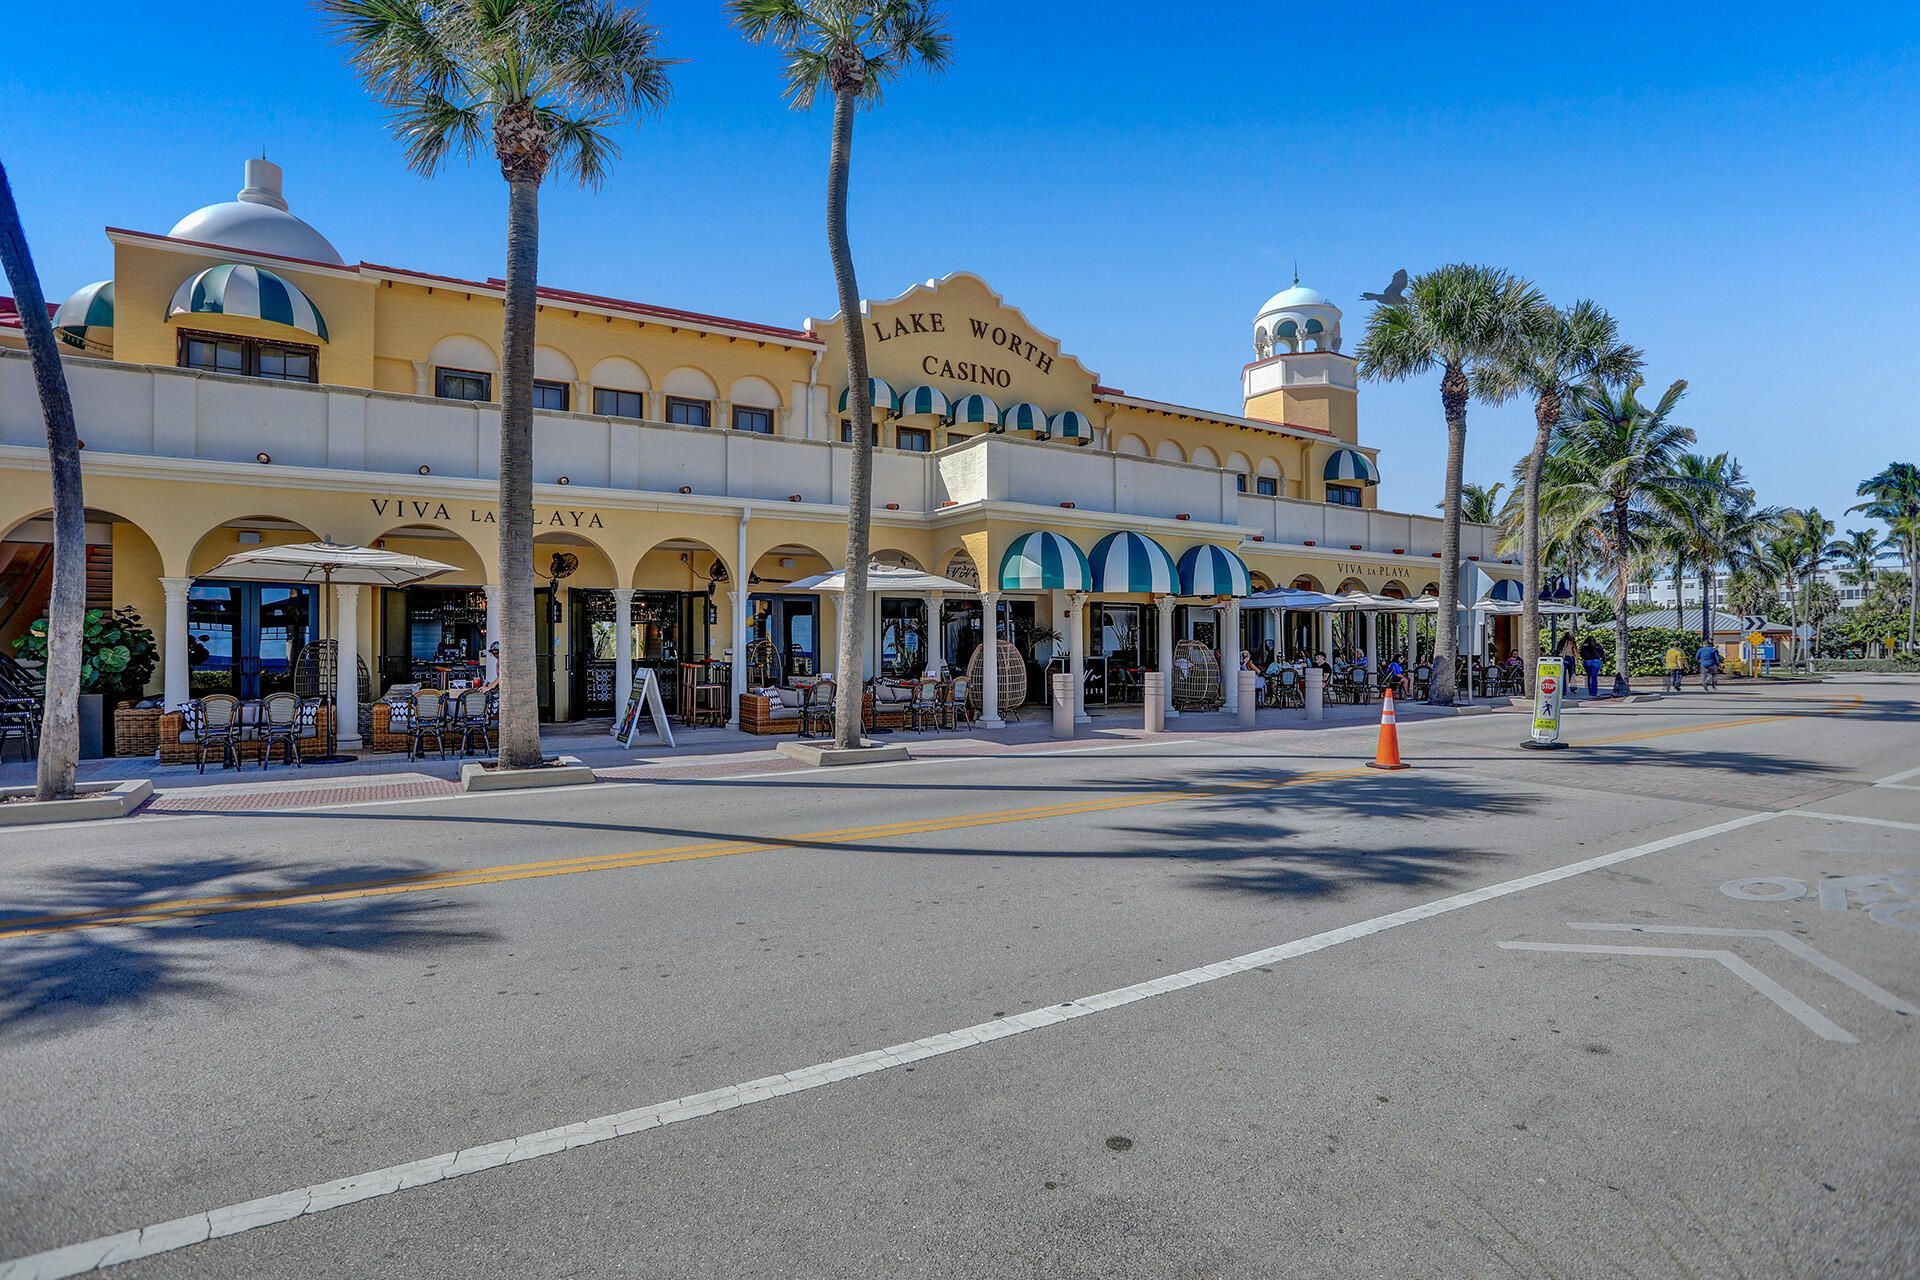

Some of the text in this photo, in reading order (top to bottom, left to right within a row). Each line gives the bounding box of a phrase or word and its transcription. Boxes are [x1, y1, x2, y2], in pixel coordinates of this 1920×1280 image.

[872, 313, 1055, 375] LAKE WORTH
[922, 355, 1011, 388] CASINO
[370, 498, 604, 529] VIVA LA LAYA
[1337, 563, 1363, 575] VIVA
[1379, 566, 1410, 578] PLAYA
